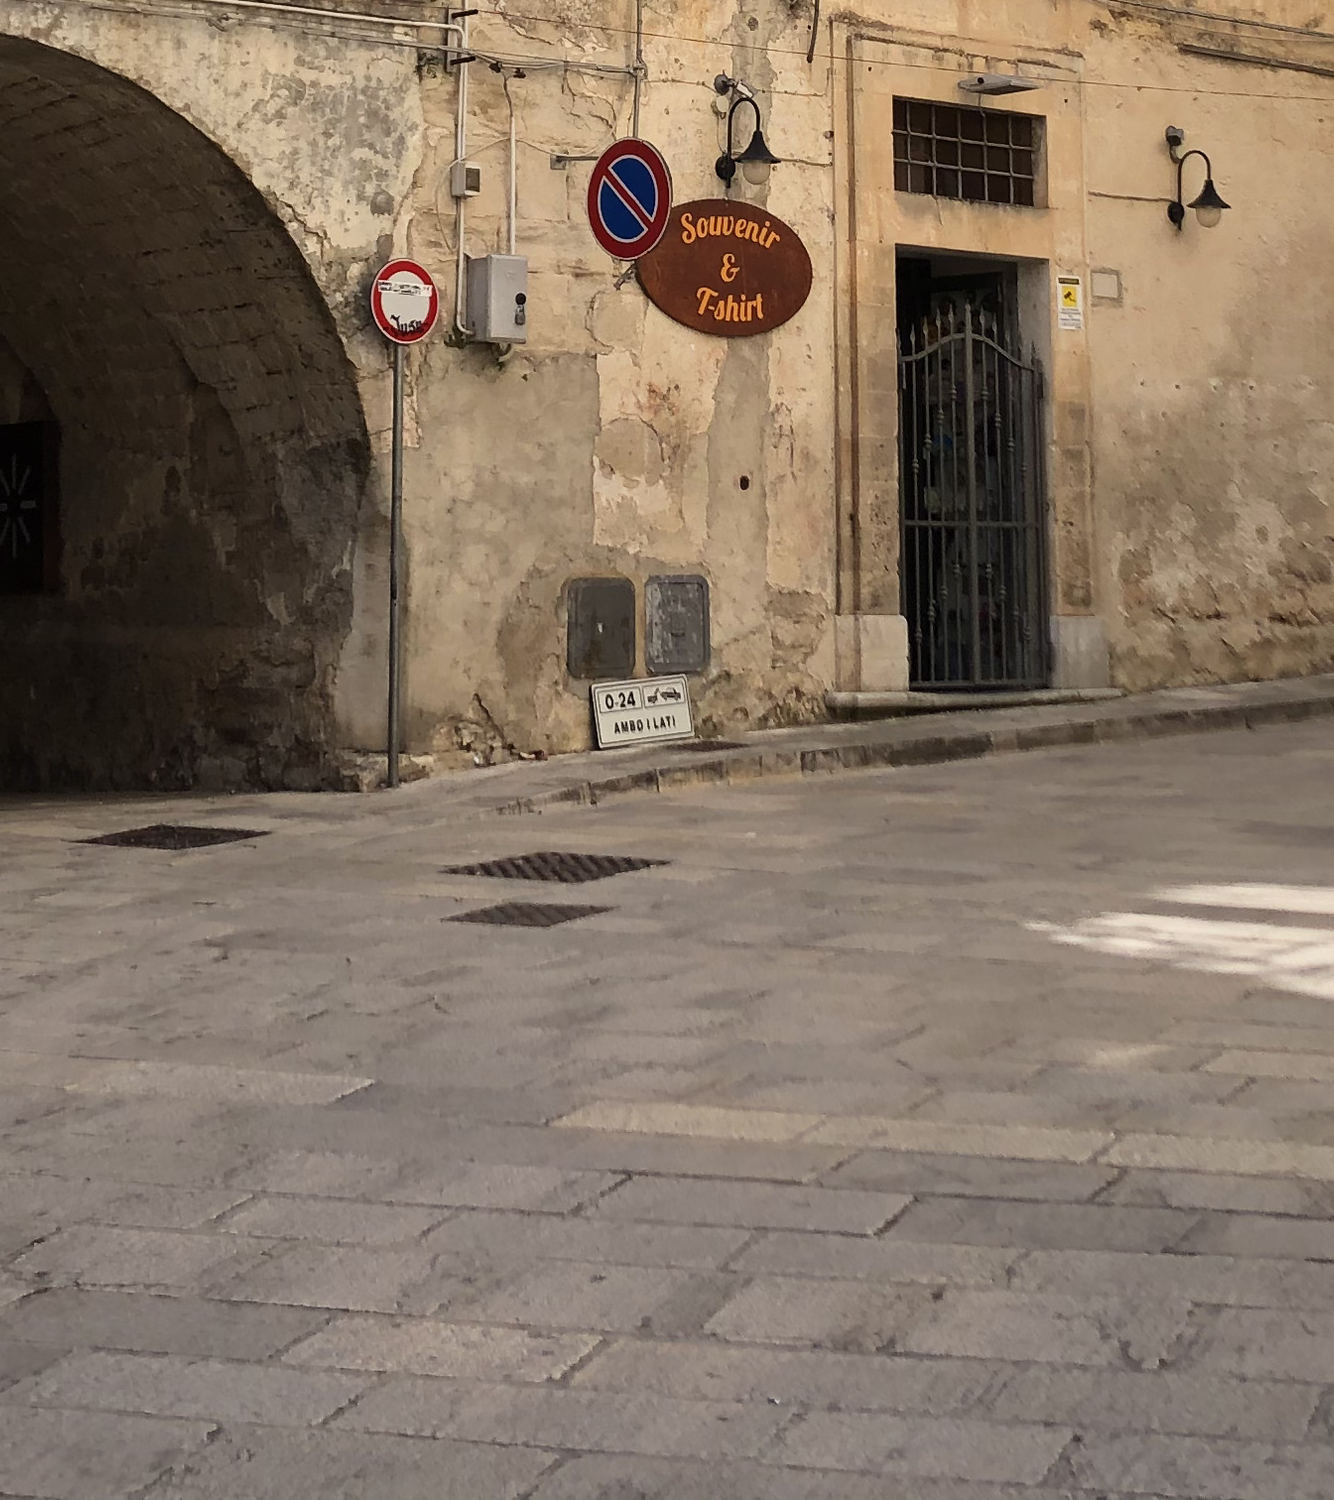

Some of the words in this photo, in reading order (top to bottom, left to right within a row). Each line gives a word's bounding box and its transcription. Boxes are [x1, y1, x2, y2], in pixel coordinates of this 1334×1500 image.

[680, 212, 781, 249] Souvenir
[720, 253, 740, 283] &
[696, 287, 764, 322] T-shirt
[605, 691, 636, 709] 0-24
[614, 719, 644, 734] AMBO
[653, 715, 676, 730] LATI
